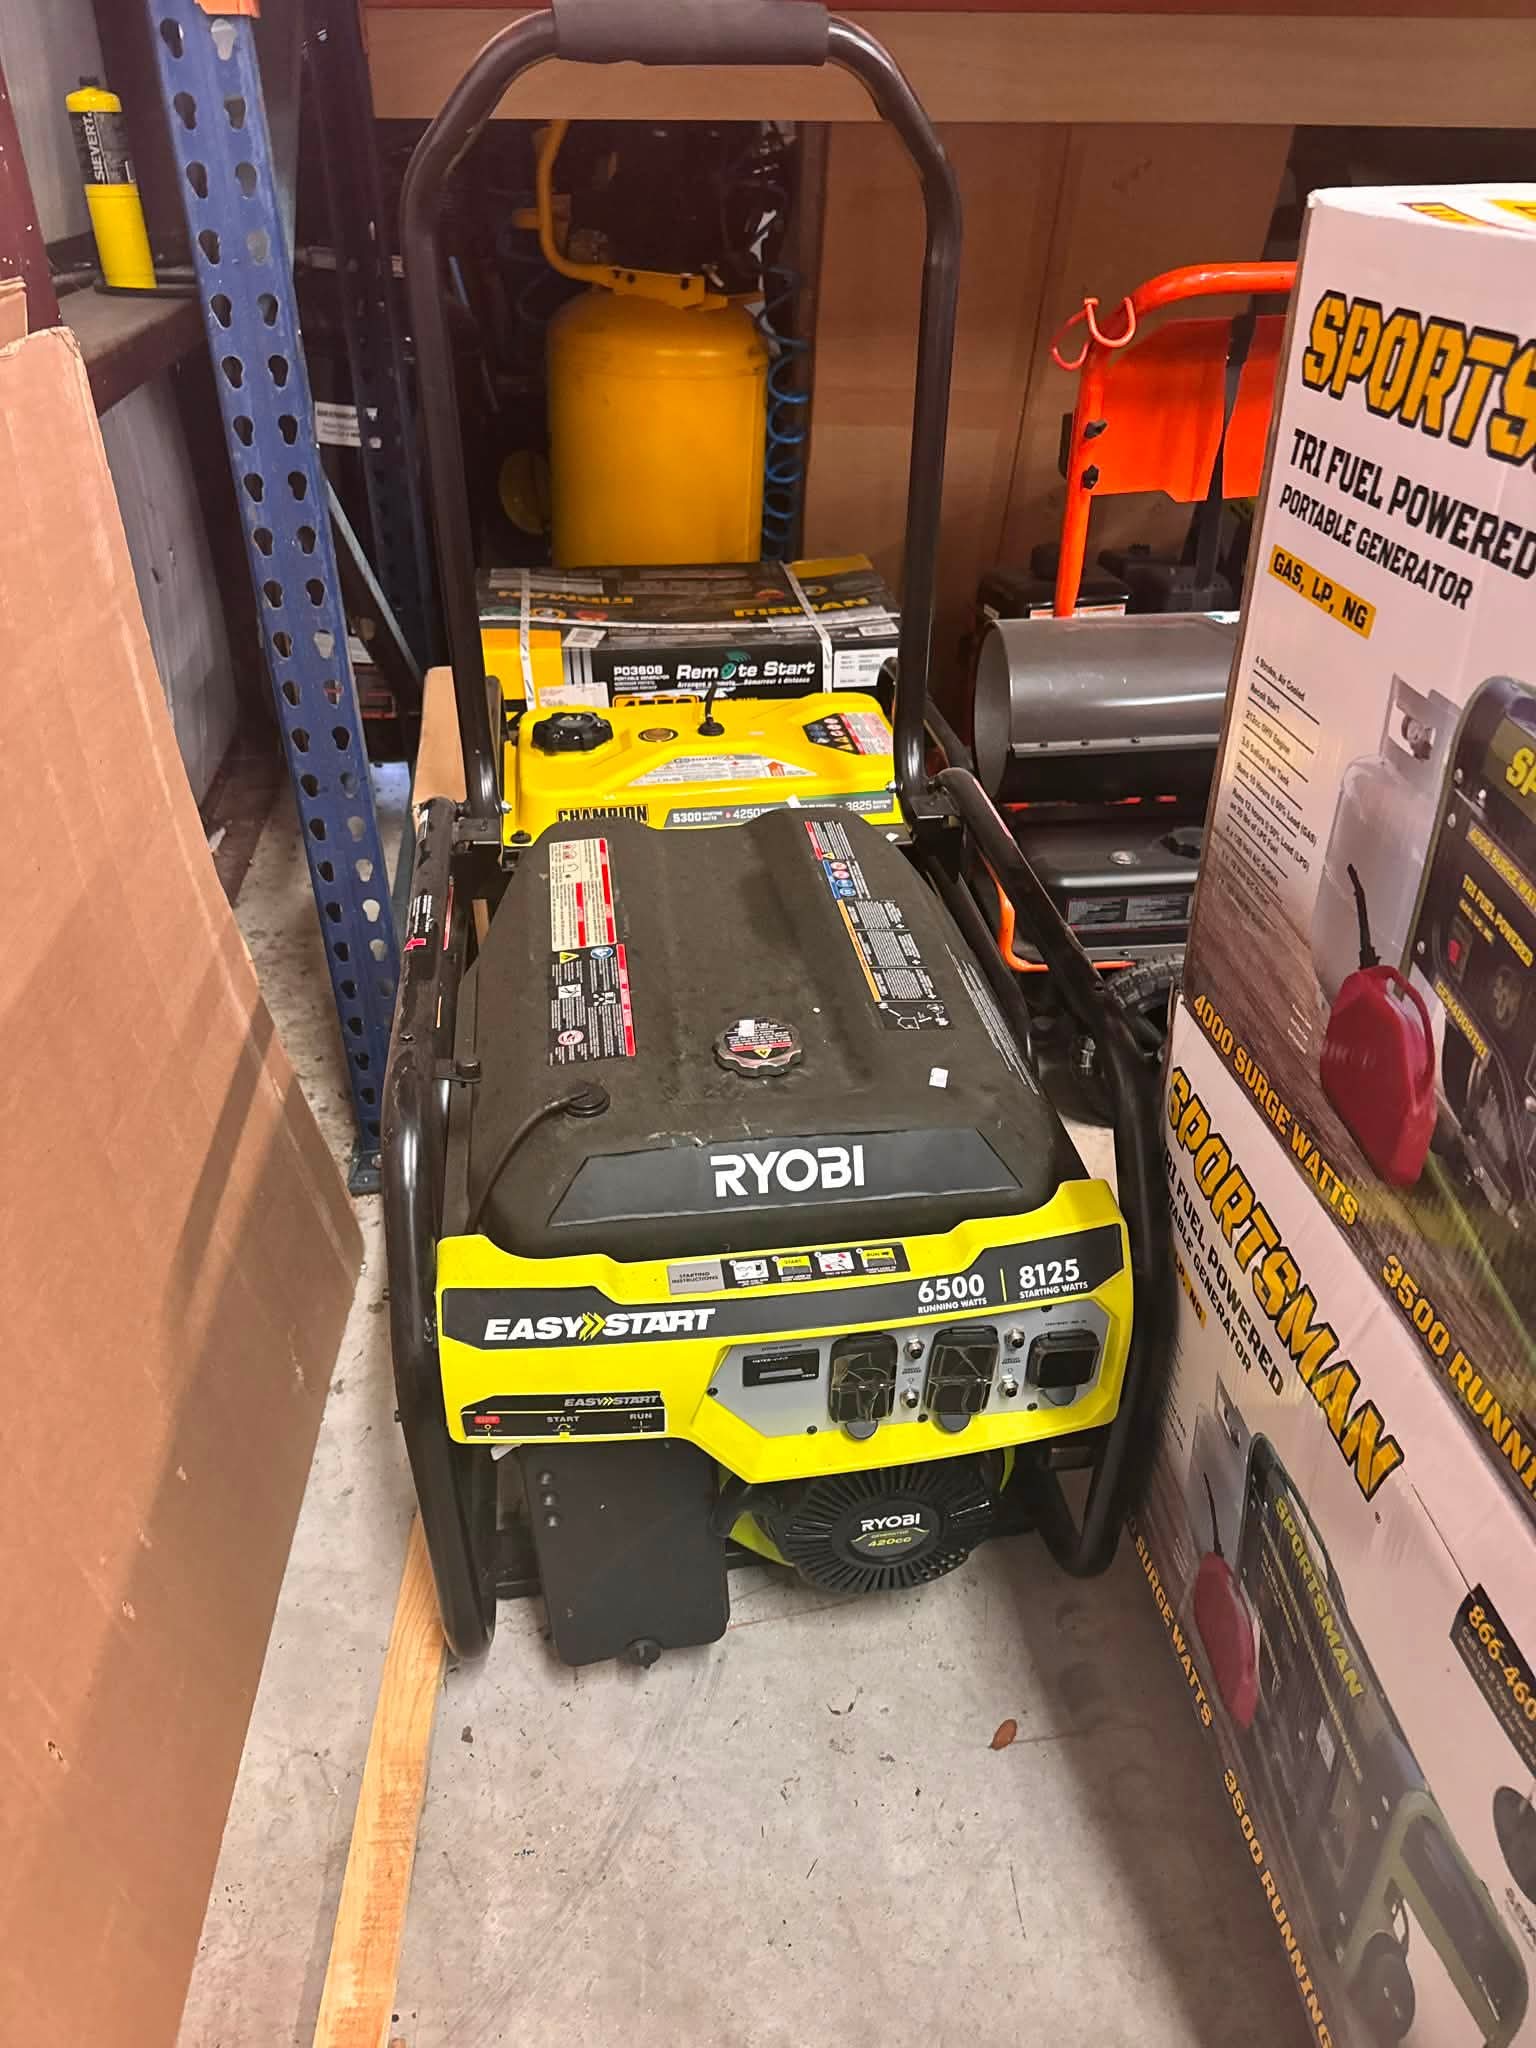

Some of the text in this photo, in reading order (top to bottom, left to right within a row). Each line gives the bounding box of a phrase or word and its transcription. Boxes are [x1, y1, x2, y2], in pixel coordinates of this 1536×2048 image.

[1290, 428, 1536, 580] TRI FUEL POWERED
[1279, 484, 1473, 611] PORTABLE GENERATOR
[1273, 552, 1368, 630] GAS, LP, NG
[763, 661, 816, 676] Start
[1267, 695, 1280, 713] Start
[1278, 769, 1289, 786] Tank
[558, 805, 648, 823] CHAMPION
[673, 812, 702, 823] 5300
[733, 807, 761, 819] 4250
[846, 799, 872, 811] 3825
[1286, 811, 1301, 830] Load
[1300, 823, 1318, 848] (GAS)
[1267, 838, 1279, 856] Fuel
[1280, 836, 1294, 856] Load
[1294, 850, 1310, 873] (LPG)
[1193, 995, 1359, 1225] 4000 SURGE WATTS
[710, 1144, 865, 1198] RYOBI
[918, 1274, 985, 1303] 6500
[1019, 1258, 1080, 1289] 8125
[1019, 1280, 1088, 1299] STARTING WATTS
[1165, 1151, 1284, 1396] RI FUEL POWERED
[1168, 1066, 1405, 1502] SPORTSMAN
[1168, 1194, 1251, 1374] TABLE GENERATOR
[604, 1308, 716, 1336] START
[918, 1297, 987, 1314] RUNNING WATTS
[1383, 1255, 1450, 1356] 3500
[547, 1415, 580, 1423] START
[629, 1413, 652, 1421] RUN
[860, 1512, 921, 1532] RYOBI
[1275, 1497, 1364, 1698] SPORTSMAN
[1135, 1536, 1213, 1728] SURGE WATTS
[1468, 1604, 1536, 1720] 866-460
[1224, 1768, 1335, 2048] 3500 RUNNING
